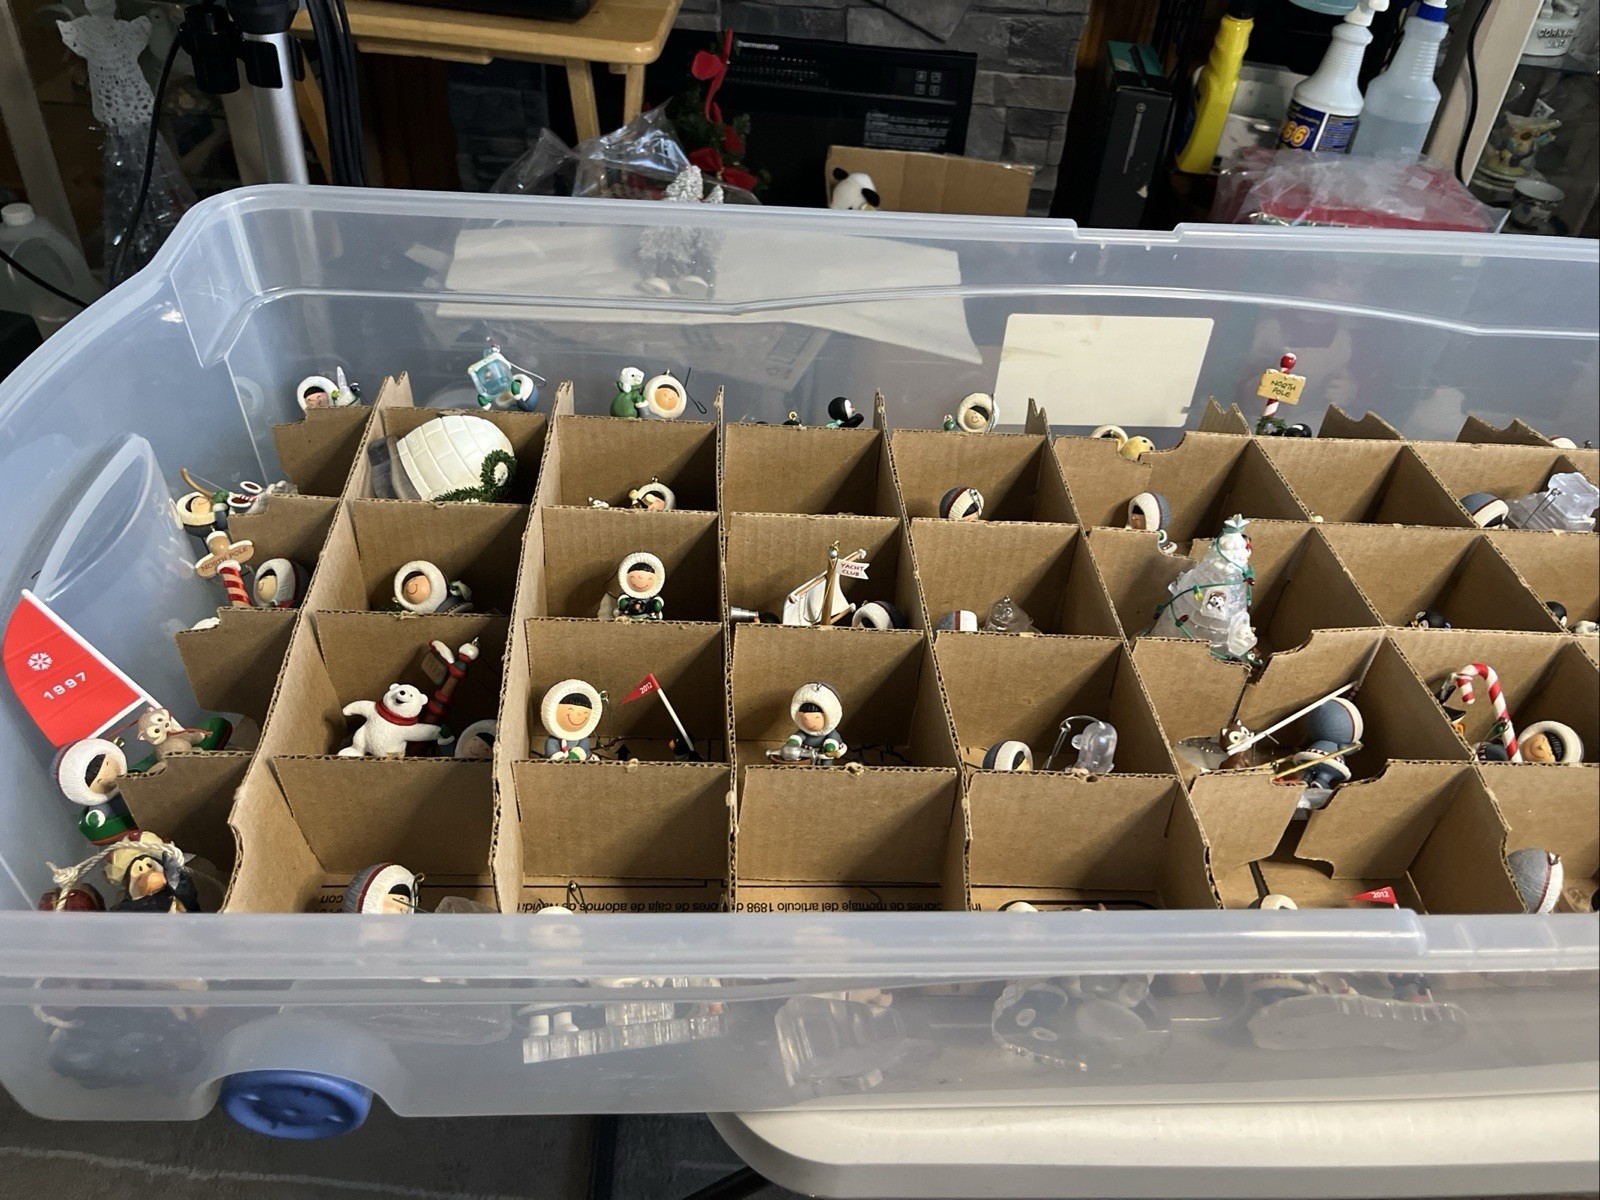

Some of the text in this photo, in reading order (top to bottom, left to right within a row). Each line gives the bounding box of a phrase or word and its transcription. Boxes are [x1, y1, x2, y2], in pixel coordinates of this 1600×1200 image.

[1270, 380, 1296, 392] NORTH
[1272, 386, 1291, 398] POLE
[201, 546, 249, 572] NORTH POLE
[840, 562, 864, 572] YACHT
[841, 569, 860, 577] CLUB
[43, 671, 87, 701] 1997
[639, 681, 653, 695] 2012
[1371, 890, 1389, 899] 2012
[630, 902, 645, 912] de
[648, 900, 672, 912] caja
[675, 902, 690, 912] de
[747, 902, 774, 913] 1898
[821, 902, 839, 912] del
